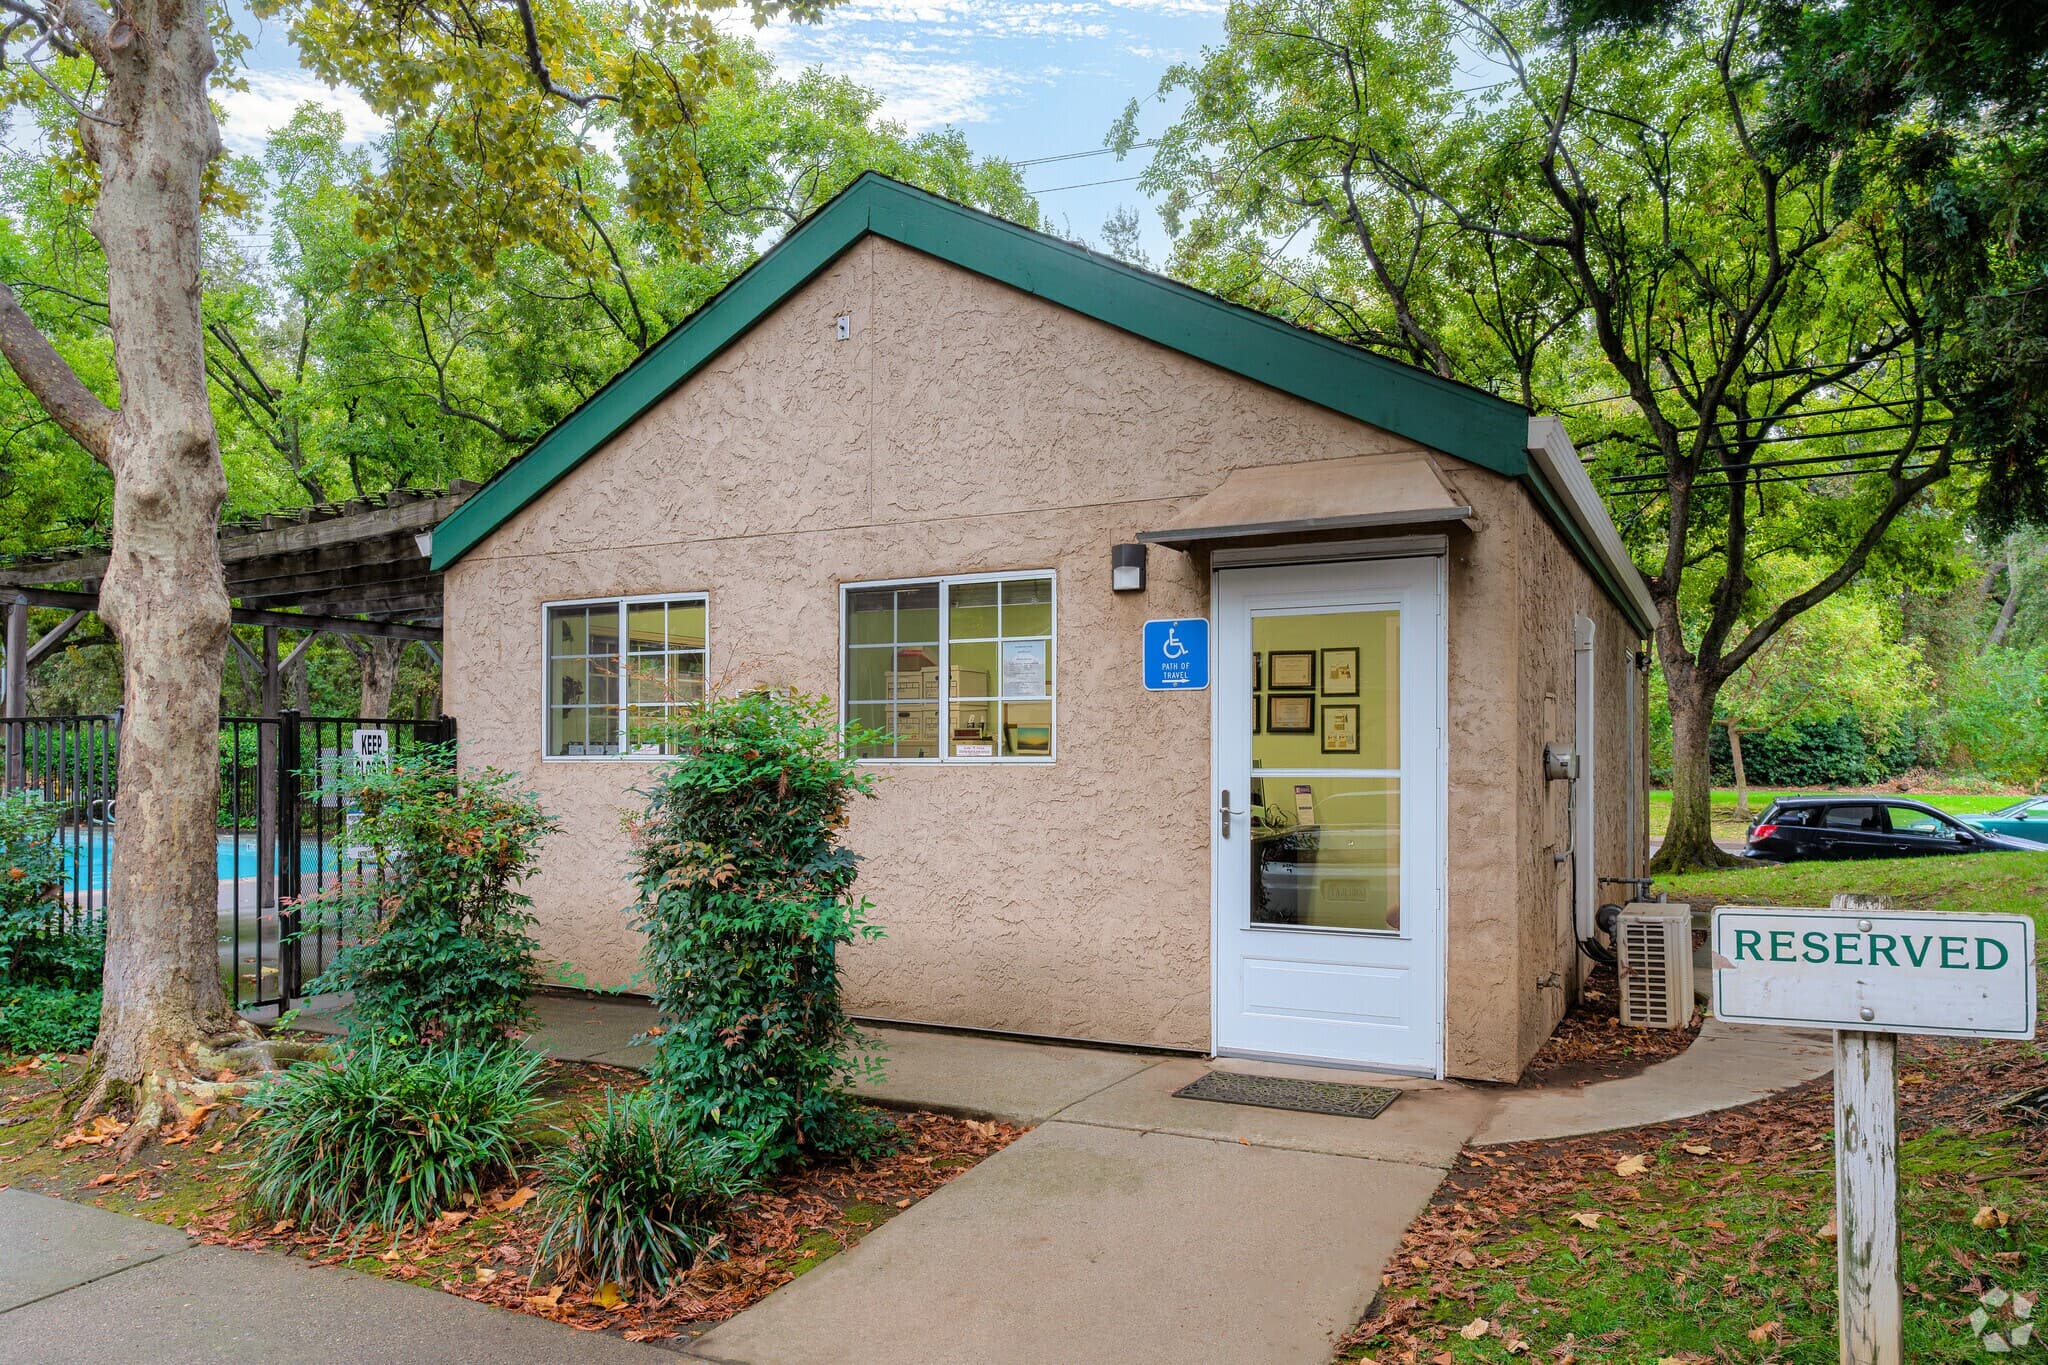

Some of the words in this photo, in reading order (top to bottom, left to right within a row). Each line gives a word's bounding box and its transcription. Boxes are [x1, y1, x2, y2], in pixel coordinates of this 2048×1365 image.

[1162, 662, 1178, 670] PATH
[1180, 662, 1190, 670] OF
[1163, 671, 1188, 679] TRAVEL
[361, 734, 382, 755] KEEP
[1734, 930, 2009, 970] RESERVED
